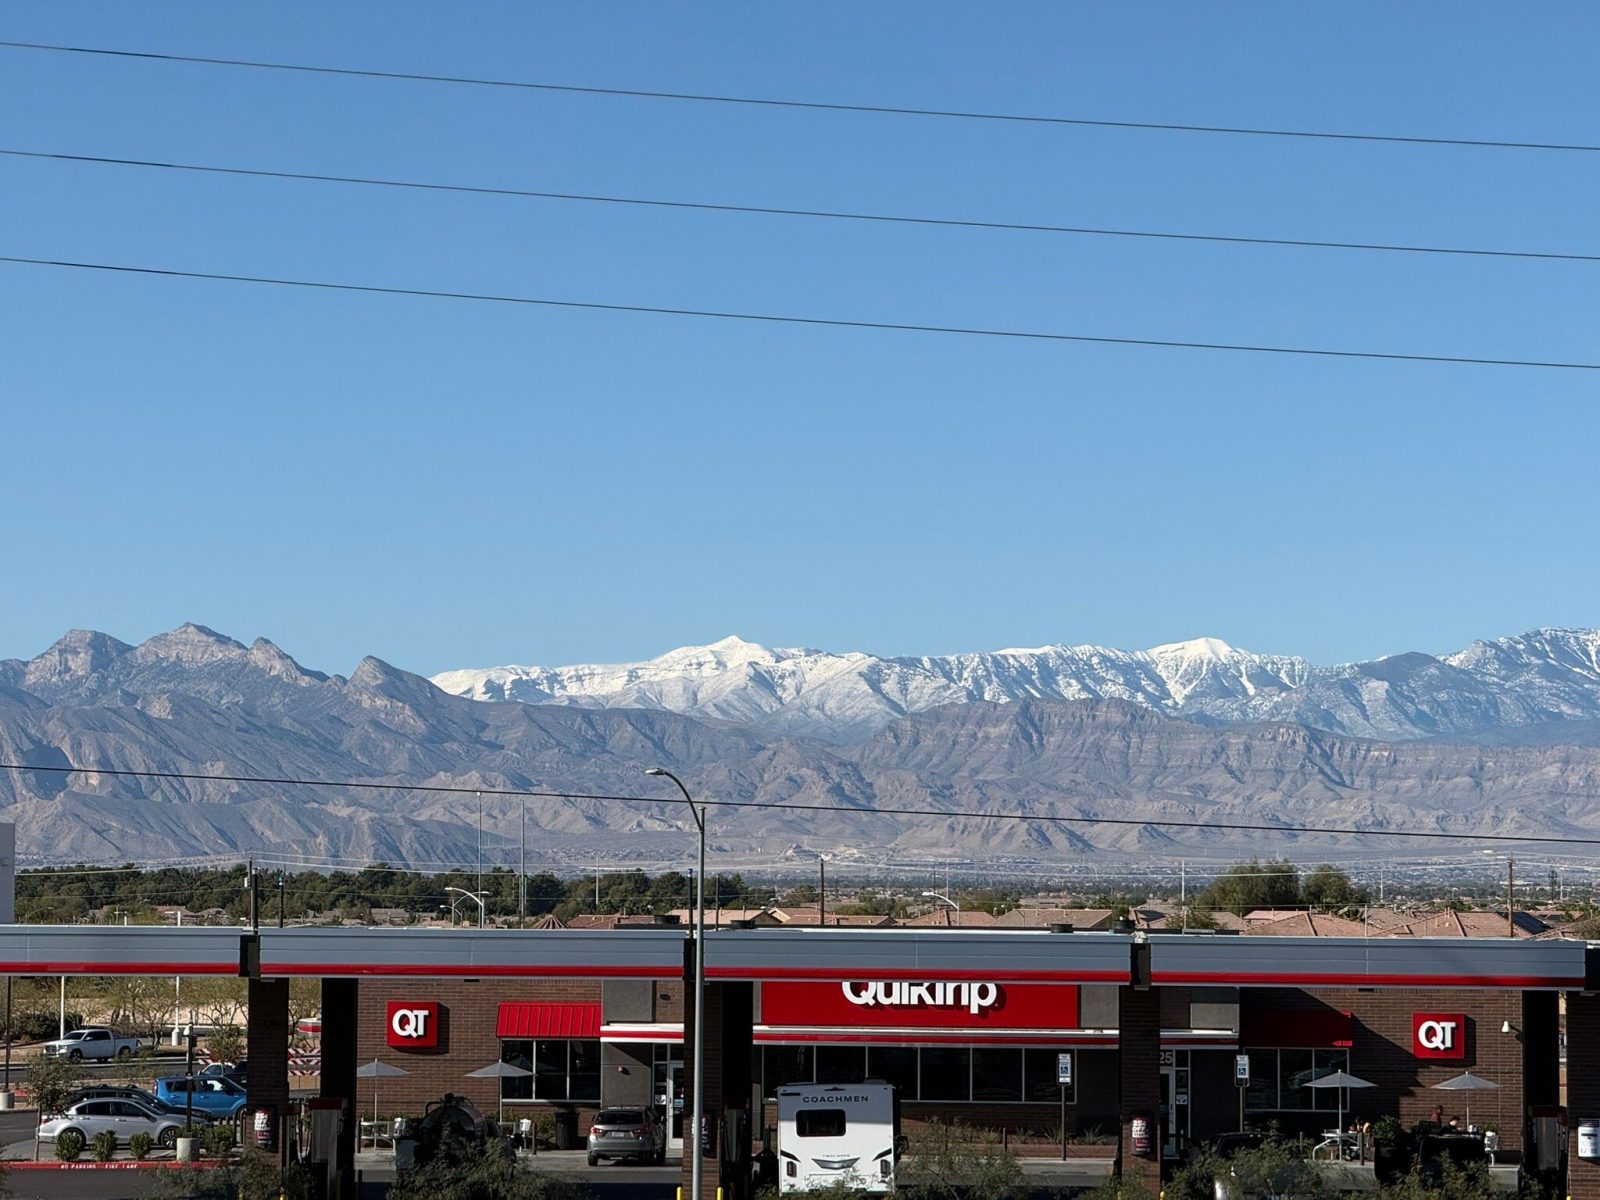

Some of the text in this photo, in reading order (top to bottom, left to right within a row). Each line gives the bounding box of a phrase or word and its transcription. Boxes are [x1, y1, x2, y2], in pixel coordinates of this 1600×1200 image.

[392, 1009, 429, 1038] QT
[1418, 1020, 1456, 1050] QT
[802, 1095, 869, 1103] COACHMEN
